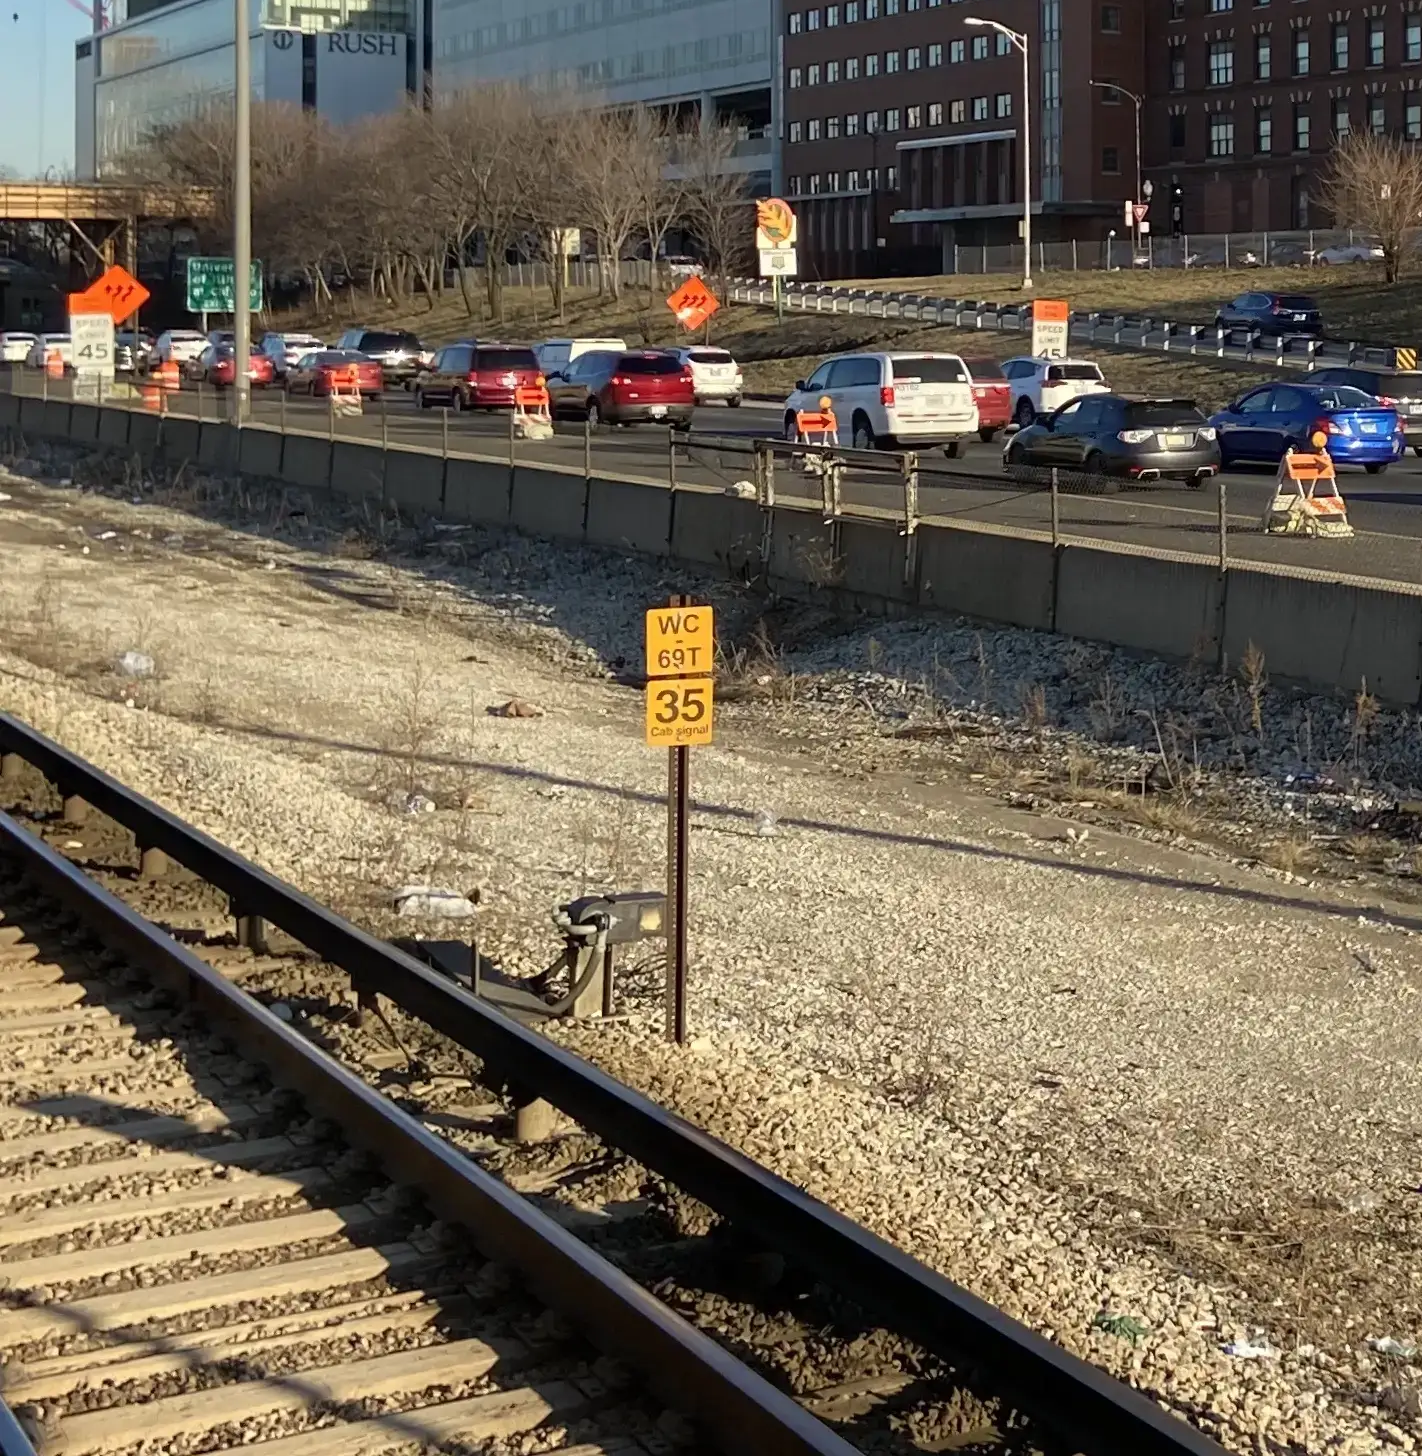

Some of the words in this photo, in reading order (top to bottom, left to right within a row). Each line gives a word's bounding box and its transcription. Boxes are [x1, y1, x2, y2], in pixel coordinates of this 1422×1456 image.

[327, 32, 397, 56] RUSH
[1037, 325, 1064, 334] SPEED
[77, 344, 108, 360] 45
[656, 613, 700, 635] WC
[658, 647, 702, 669] 69T
[655, 688, 705, 724] 35
[650, 726, 674, 737] Cab
[676, 724, 709, 738] signal
